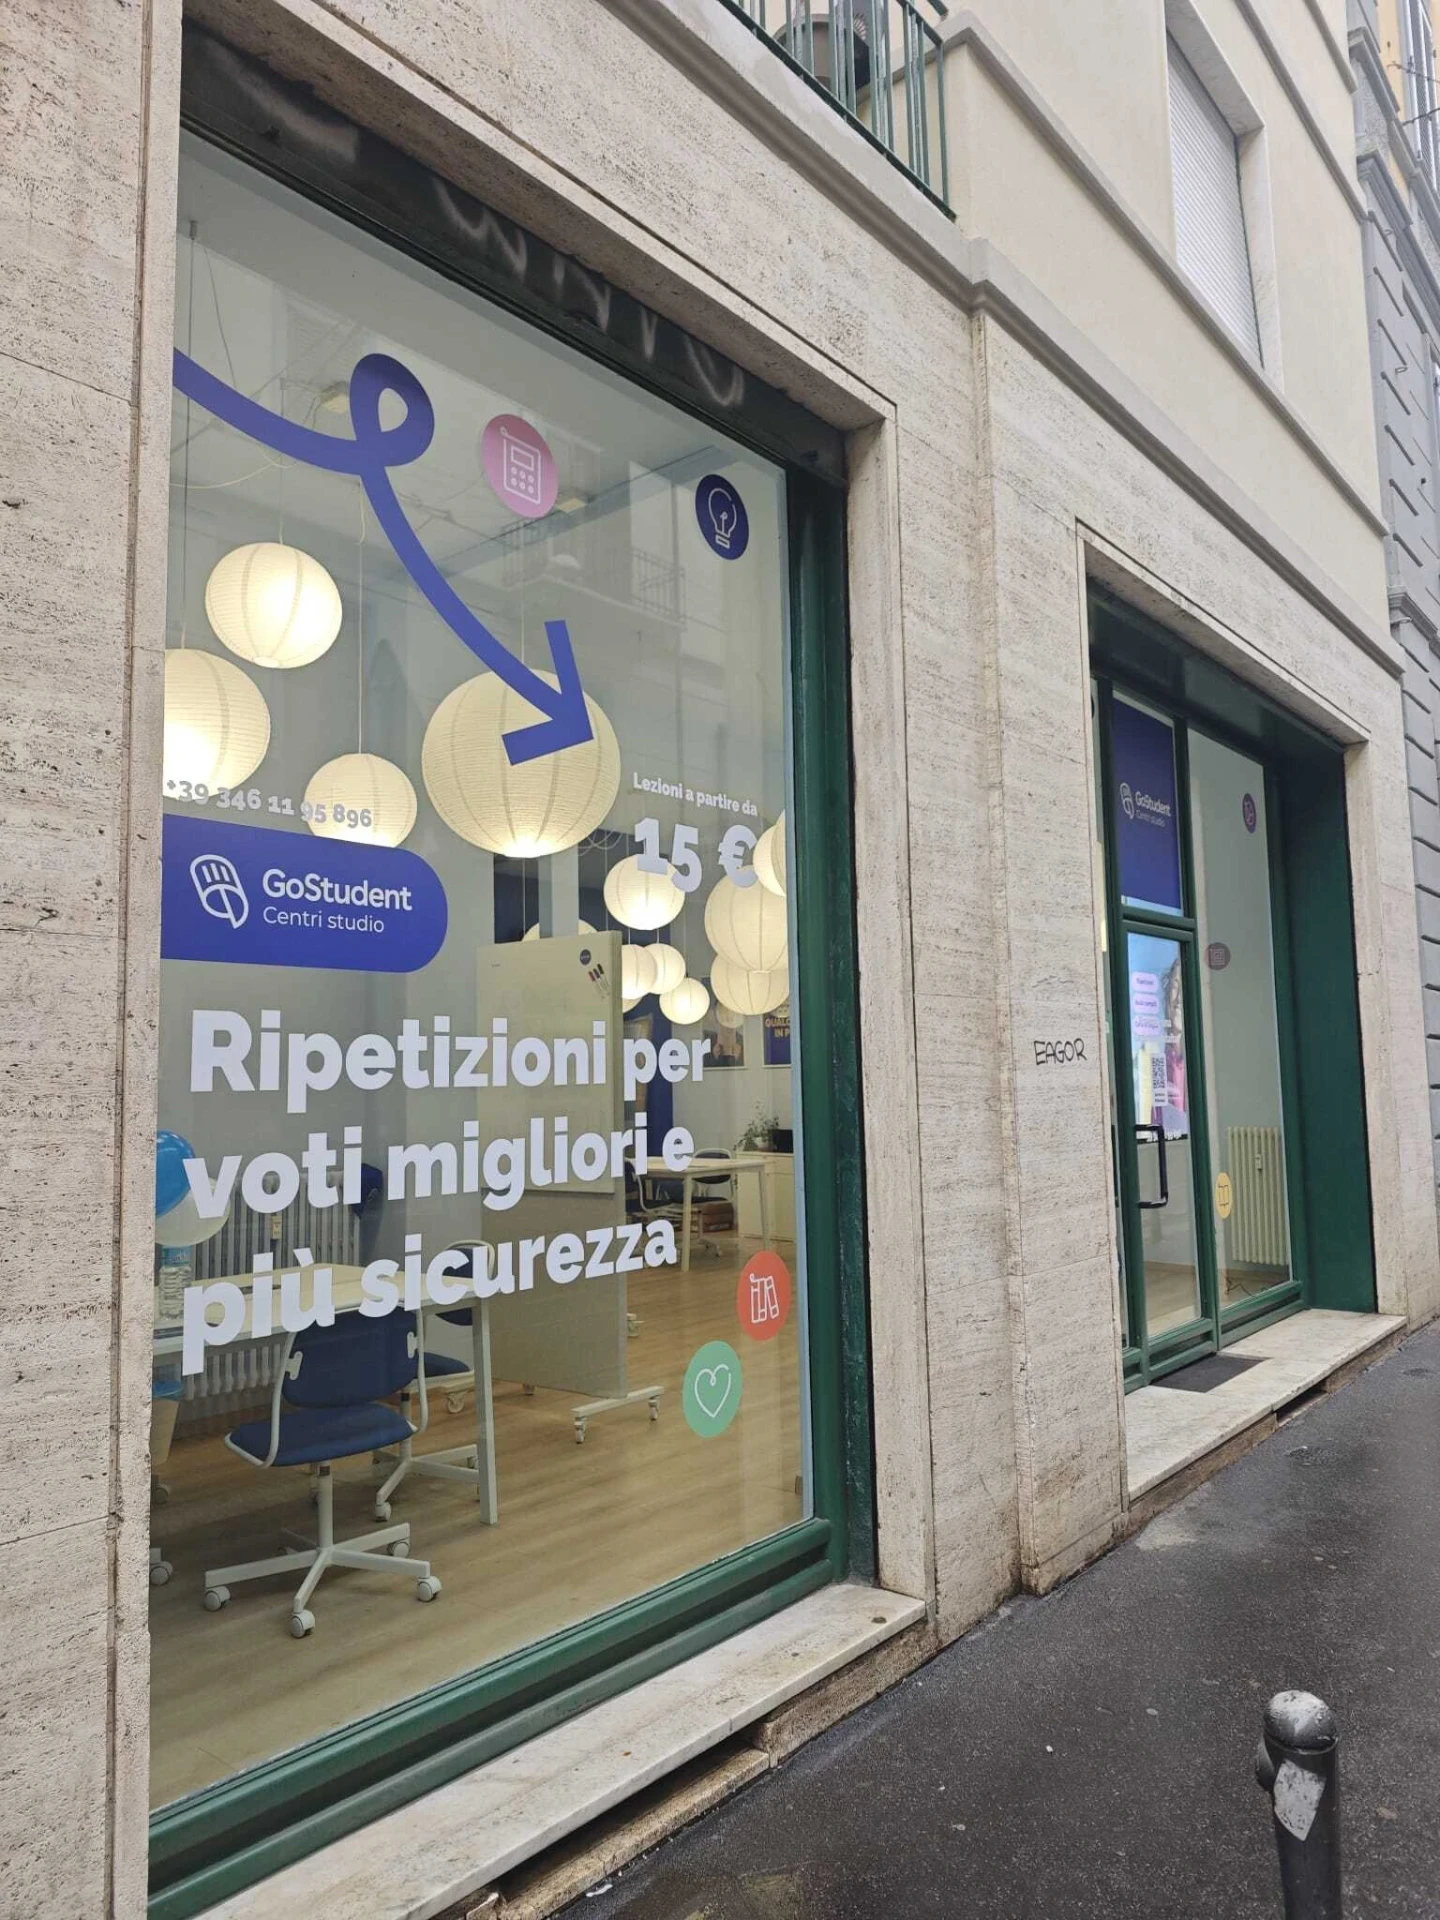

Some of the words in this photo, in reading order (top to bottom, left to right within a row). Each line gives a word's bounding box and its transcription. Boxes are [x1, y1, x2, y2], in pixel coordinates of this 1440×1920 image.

[166, 779, 209, 806] +39
[216, 787, 262, 811] 346
[268, 796, 295, 816] 11
[300, 803, 327, 823] 95
[333, 804, 373, 829] 896
[633, 772, 683, 799] Lezioni
[685, 789, 695, 802] a
[696, 791, 740, 813] partire
[741, 800, 758, 817] da
[1135, 791, 1171, 817] GoStudent
[634, 817, 702, 893] 15
[718, 824, 759, 889] €
[262, 868, 413, 911] GoStudent
[263, 906, 323, 928] Centri
[327, 912, 385, 933] studio
[190, 1009, 607, 1113] Ripetizioni
[623, 1037, 711, 1101] per
[1034, 1037, 1087, 1065] EAGOR
[182, 1125, 363, 1219] voti
[388, 1111, 648, 1211] migliori
[662, 1125, 694, 1171] e
[182, 1247, 336, 1376] più
[357, 1219, 677, 1318] sicurezza
